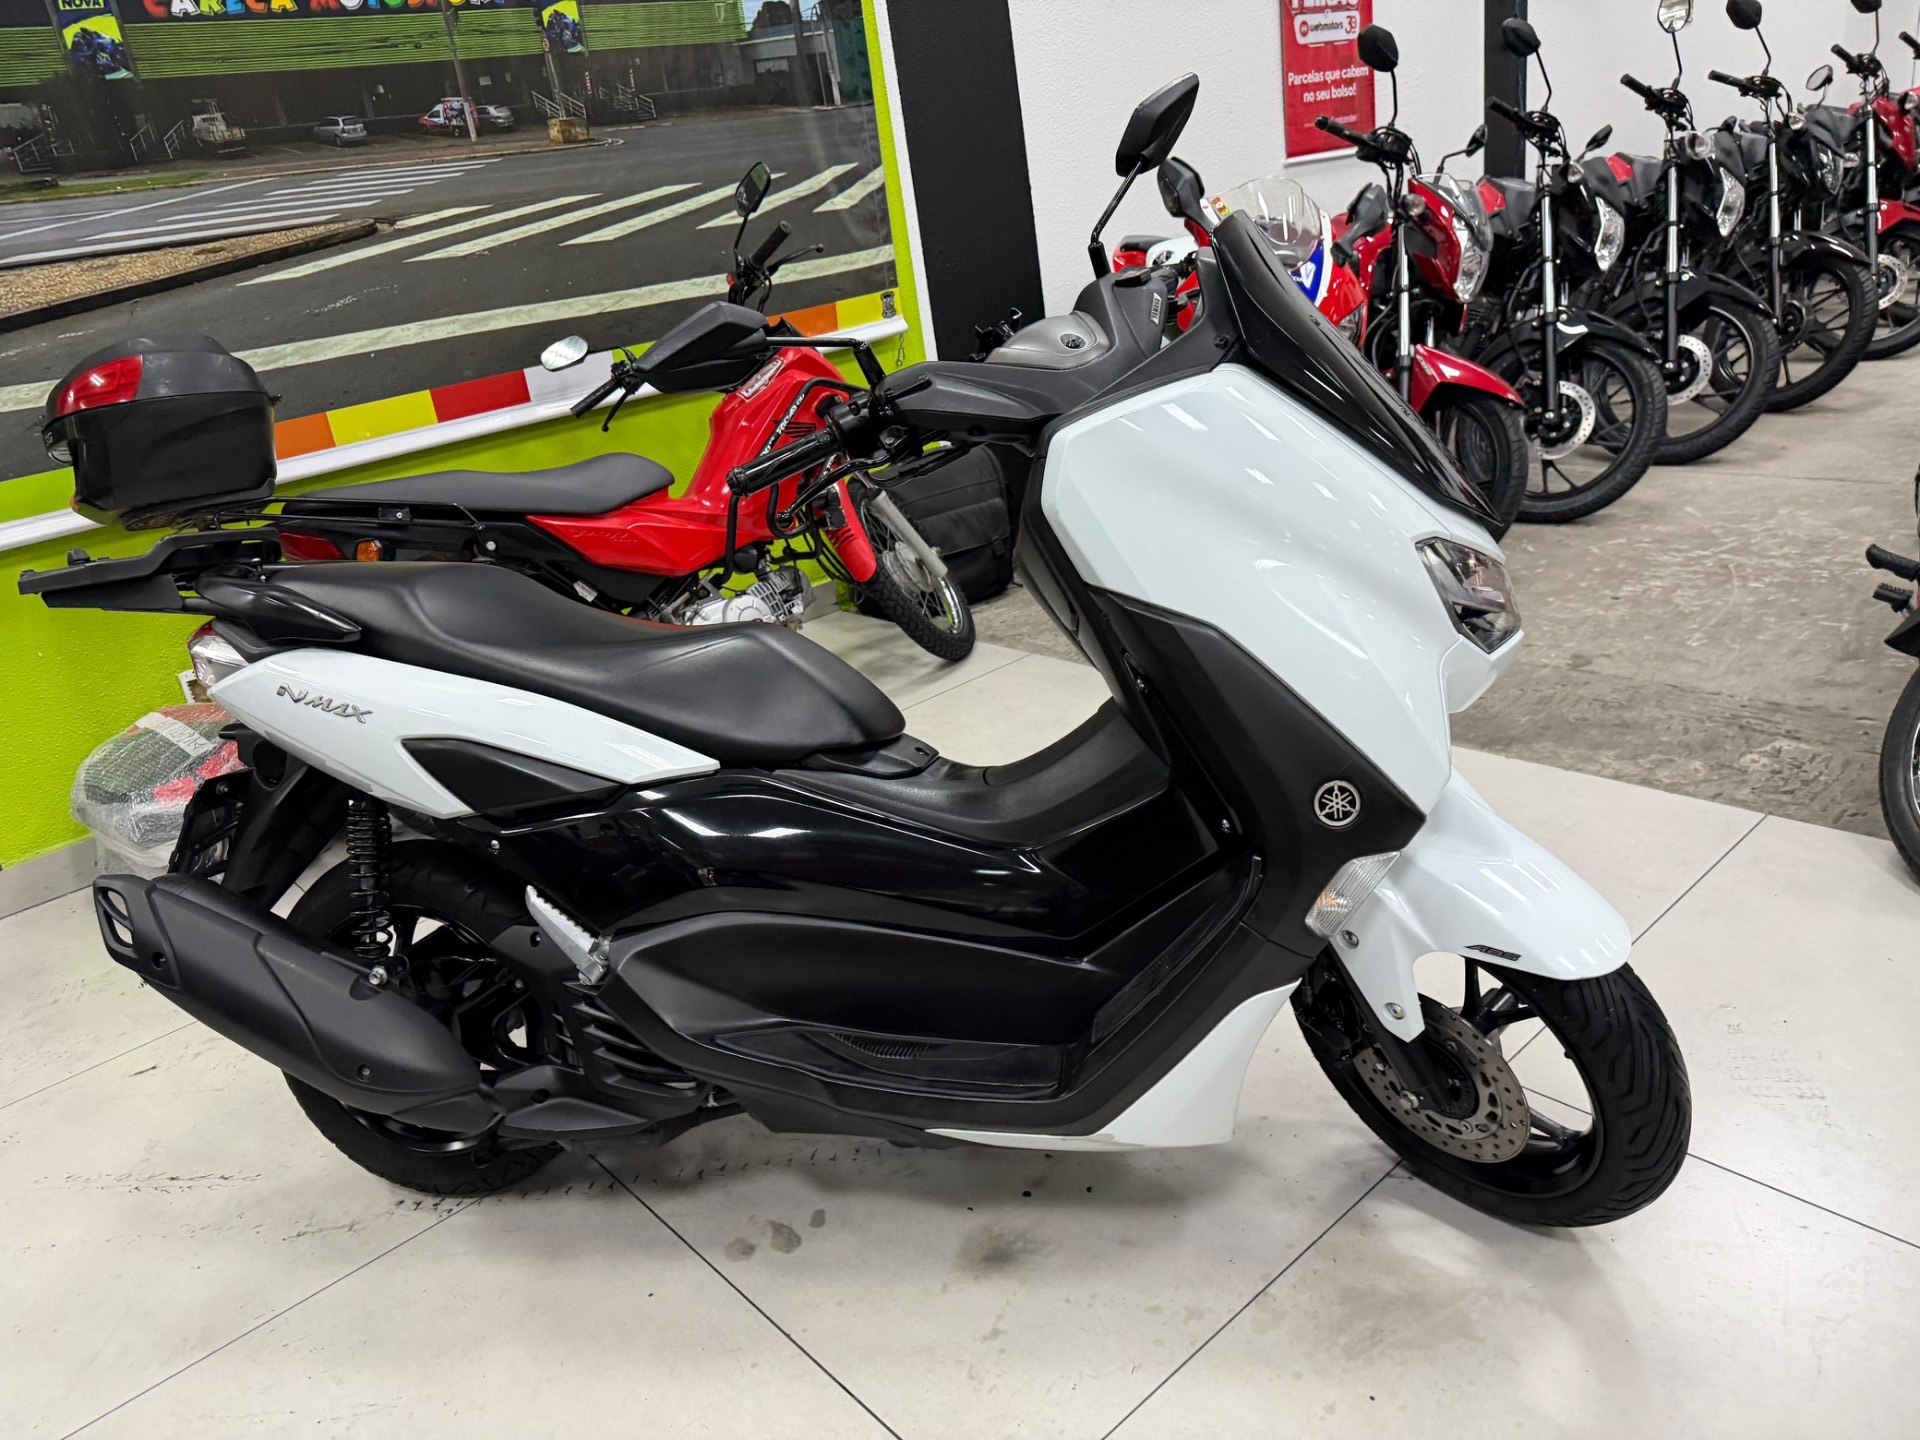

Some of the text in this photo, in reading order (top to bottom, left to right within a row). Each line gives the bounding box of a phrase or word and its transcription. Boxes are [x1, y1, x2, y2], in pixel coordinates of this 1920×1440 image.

[1310, 21, 1343, 32] webmotors
[1288, 65, 1369, 86] Parcelas que cabem
[1303, 83, 1357, 103] no seu bolso!
[276, 682, 373, 724] NMAX
